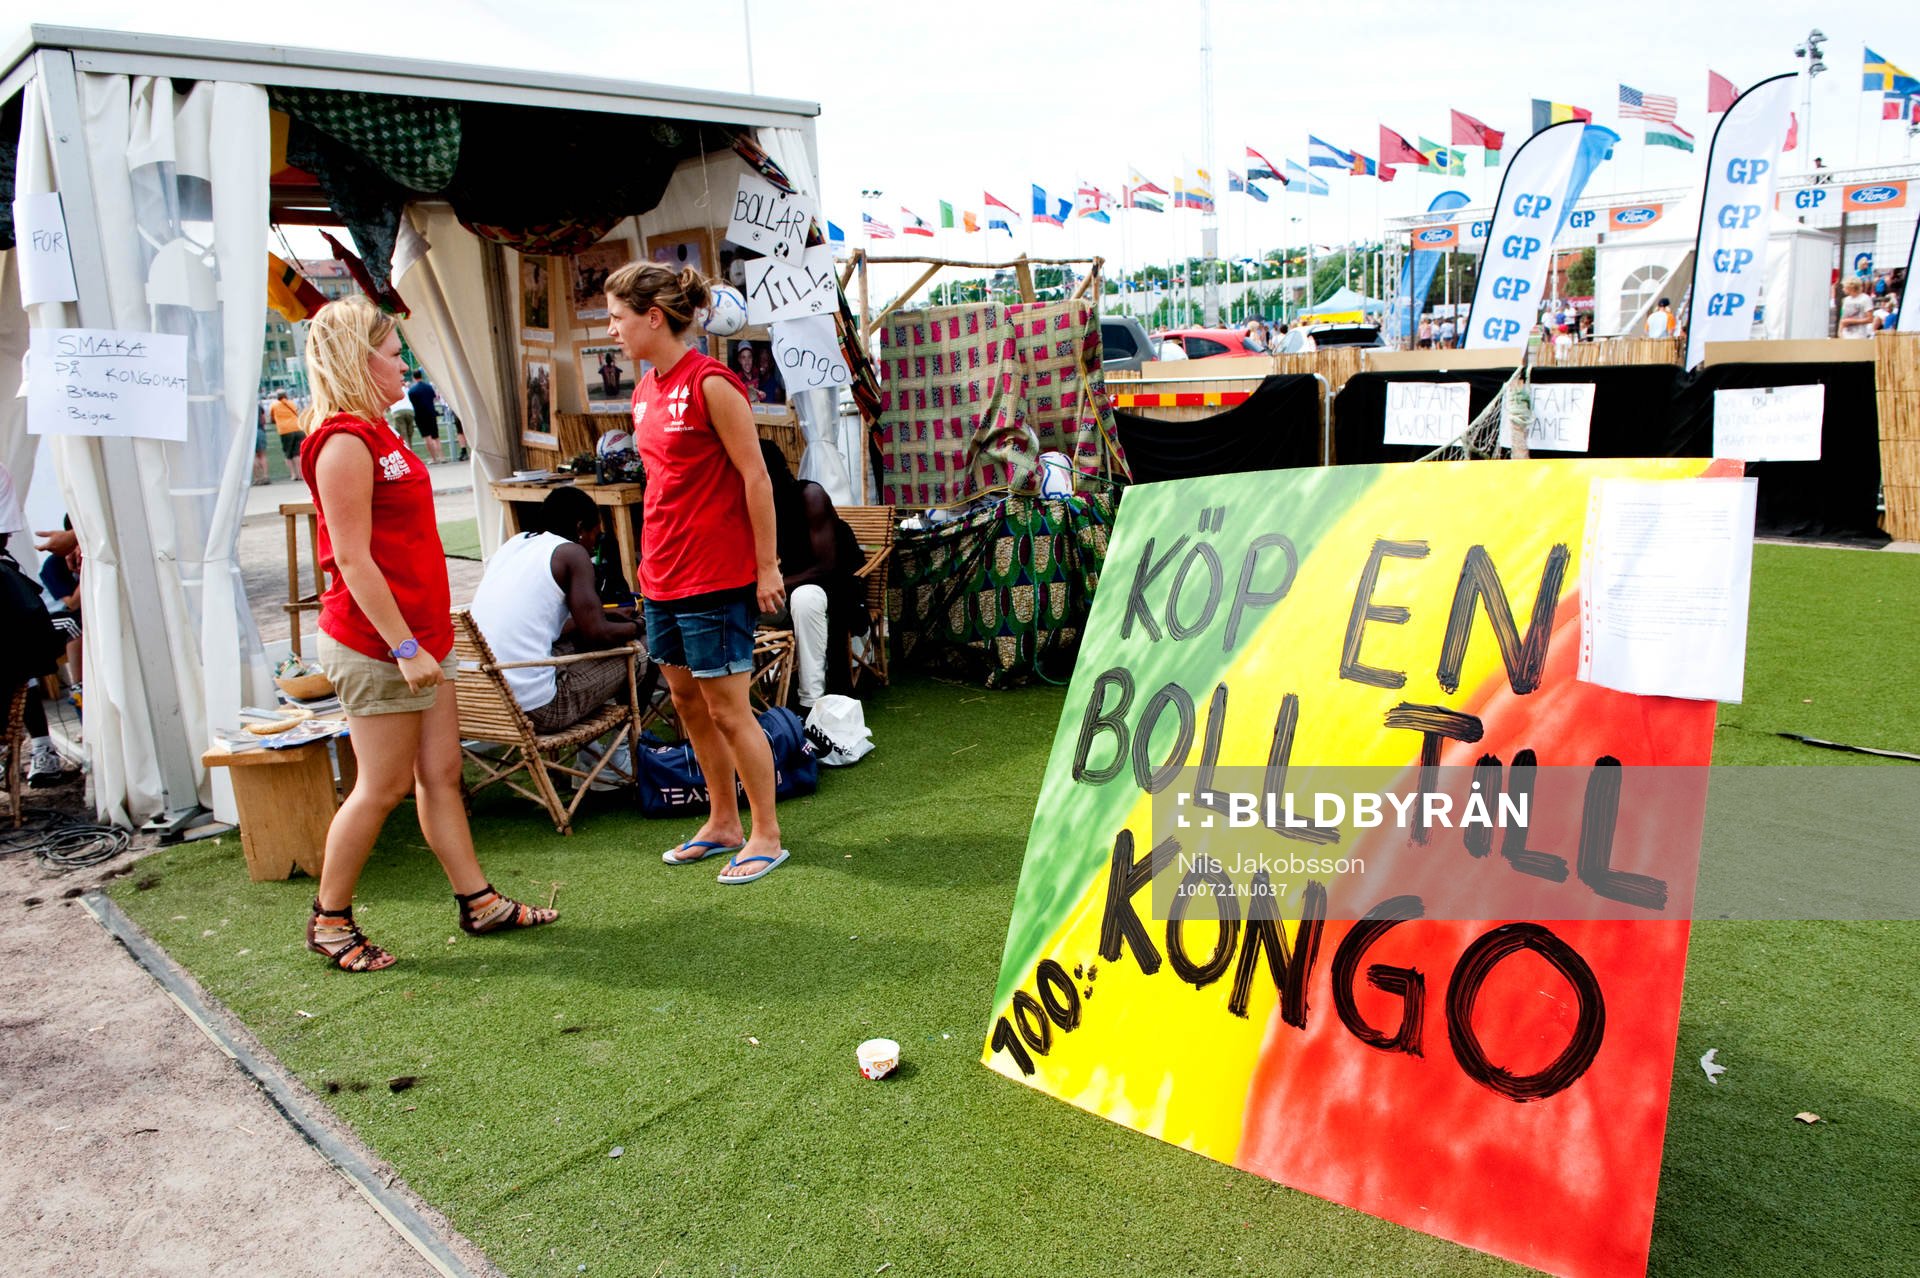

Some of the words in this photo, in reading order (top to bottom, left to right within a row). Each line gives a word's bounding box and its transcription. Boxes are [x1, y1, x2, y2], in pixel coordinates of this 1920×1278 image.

[1727, 158, 1769, 184] GP
[1513, 193, 1551, 219] GP
[1795, 190, 1826, 208] GP
[1855, 187, 1894, 202] Ford
[734, 190, 805, 244] BOLLAR
[1422, 229, 1452, 242] Ford
[1570, 211, 1595, 228] GP
[1619, 209, 1653, 224] Ford
[1718, 205, 1762, 230] GP
[1503, 235, 1540, 260] GP
[1713, 249, 1753, 274] GP
[750, 265, 829, 312] TILL
[1493, 276, 1530, 301] GP
[1707, 293, 1744, 316] GP
[1483, 317, 1520, 342] GP
[58, 334, 147, 356] SMAKA
[777, 338, 847, 386] ongo
[105, 368, 188, 392] KONGOMAT
[1390, 384, 1466, 410] UNFAIR
[1395, 414, 1464, 441] WORLD
[1527, 417, 1570, 441] AME
[1120, 506, 1298, 653] KÖP
[1340, 537, 1571, 695] EN
[1072, 666, 1341, 845] BOLL
[1384, 701, 1668, 911] TILL
[1099, 828, 1605, 1103] KONGO
